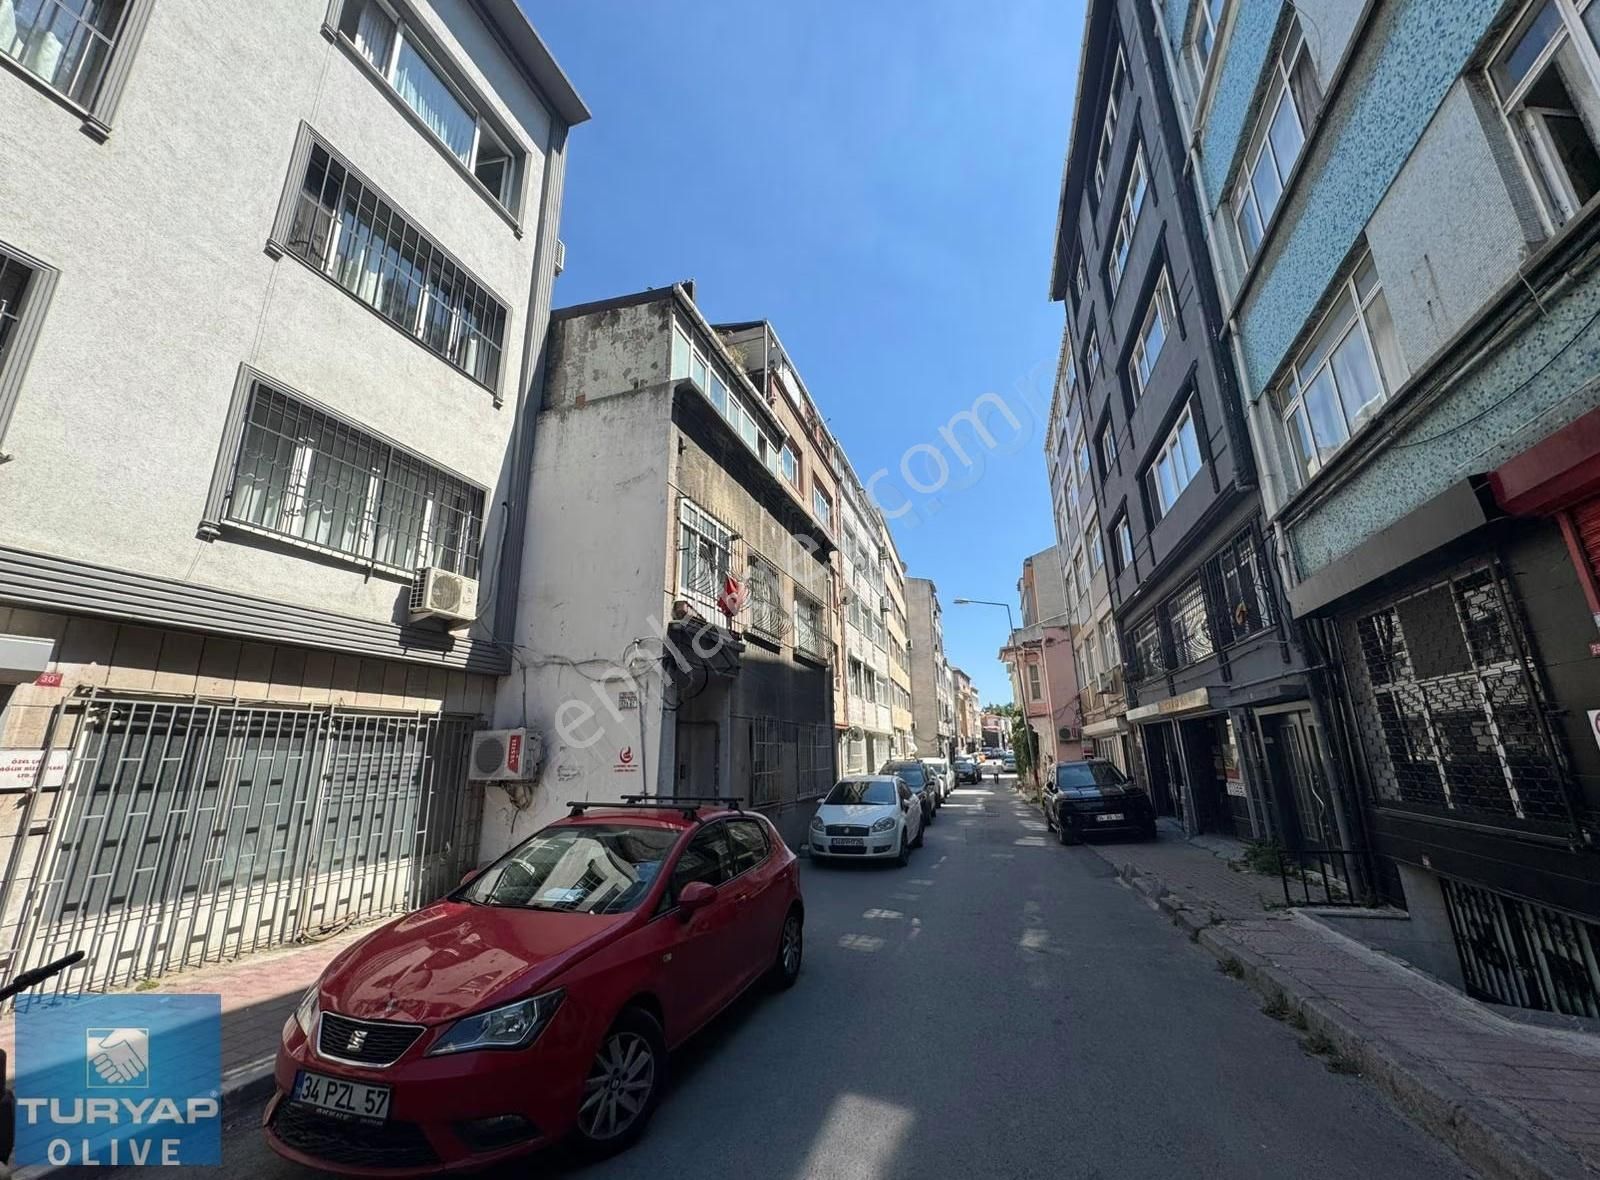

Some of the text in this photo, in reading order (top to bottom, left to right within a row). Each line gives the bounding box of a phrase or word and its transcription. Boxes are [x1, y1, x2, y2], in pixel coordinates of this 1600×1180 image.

[301, 1076, 320, 1104] 34
[323, 1081, 356, 1111] PZL
[364, 1088, 389, 1115] 57
